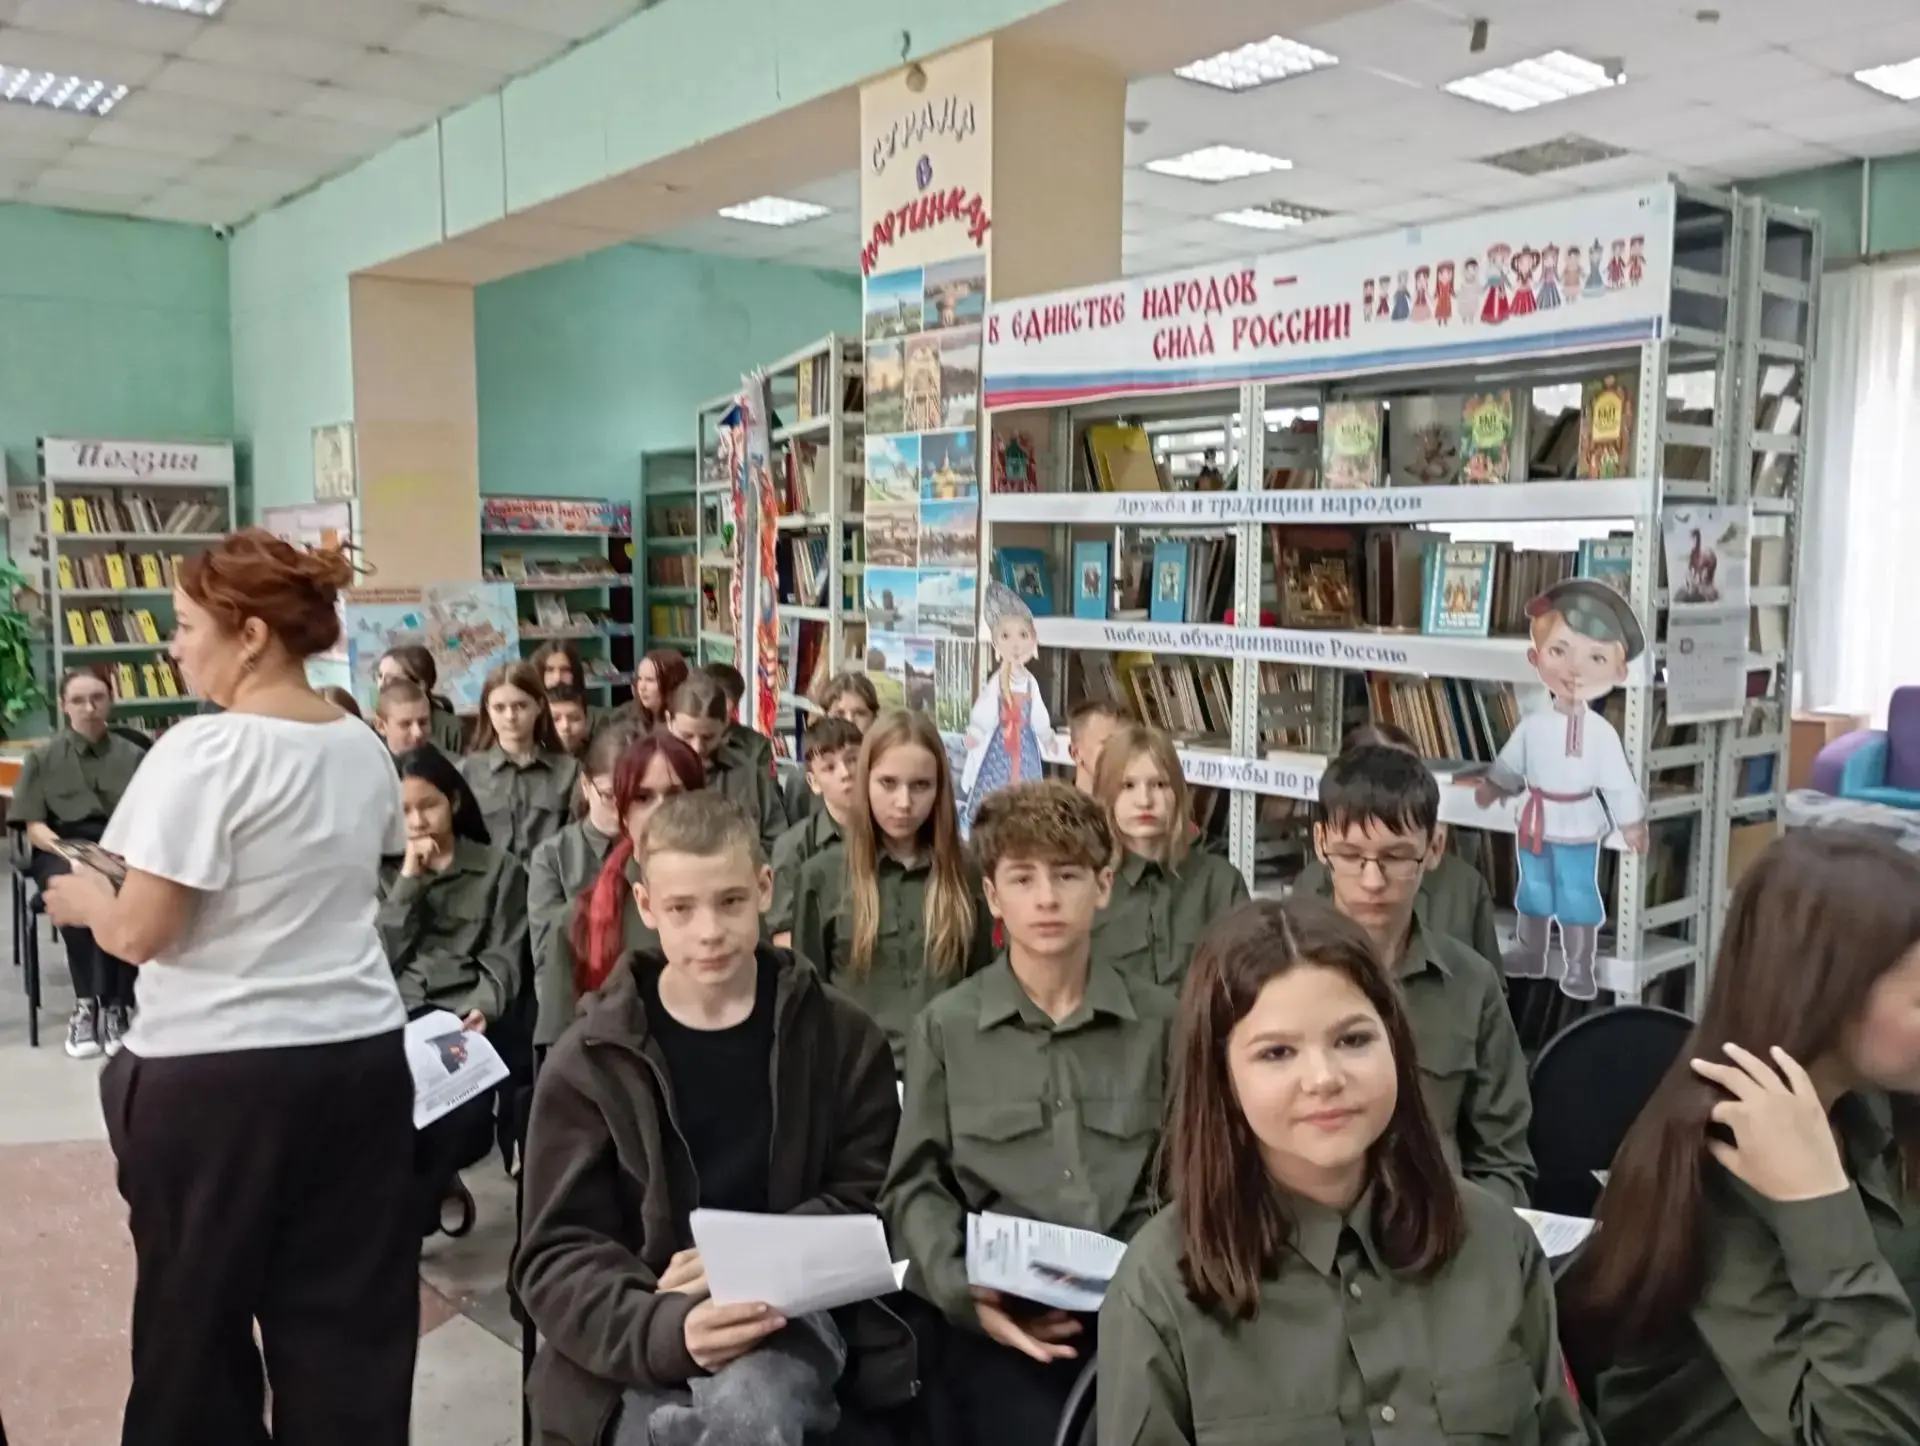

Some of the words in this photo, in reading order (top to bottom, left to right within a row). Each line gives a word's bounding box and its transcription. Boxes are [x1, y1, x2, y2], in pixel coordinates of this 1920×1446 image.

[872, 95, 975, 175] СТРАНА
[861, 187, 991, 276] КАРТИНКАХ
[988, 315, 1000, 345] В
[1142, 268, 1257, 321] НАРОДОВ
[1152, 321, 1214, 361] СИЛА
[1233, 302, 1351, 351] РОССИИ!
[72, 443, 199, 476] Поэзия
[1115, 496, 1186, 517] Дружба
[1191, 497, 1203, 514] и
[1207, 495, 1314, 518] традиции
[1320, 494, 1423, 517] народов
[1103, 625, 1177, 647] Победы,
[1180, 628, 1326, 657] объединившие
[1330, 638, 1408, 663] Россию
[1195, 759, 1269, 784] дружбы
[1274, 770, 1298, 789] по
